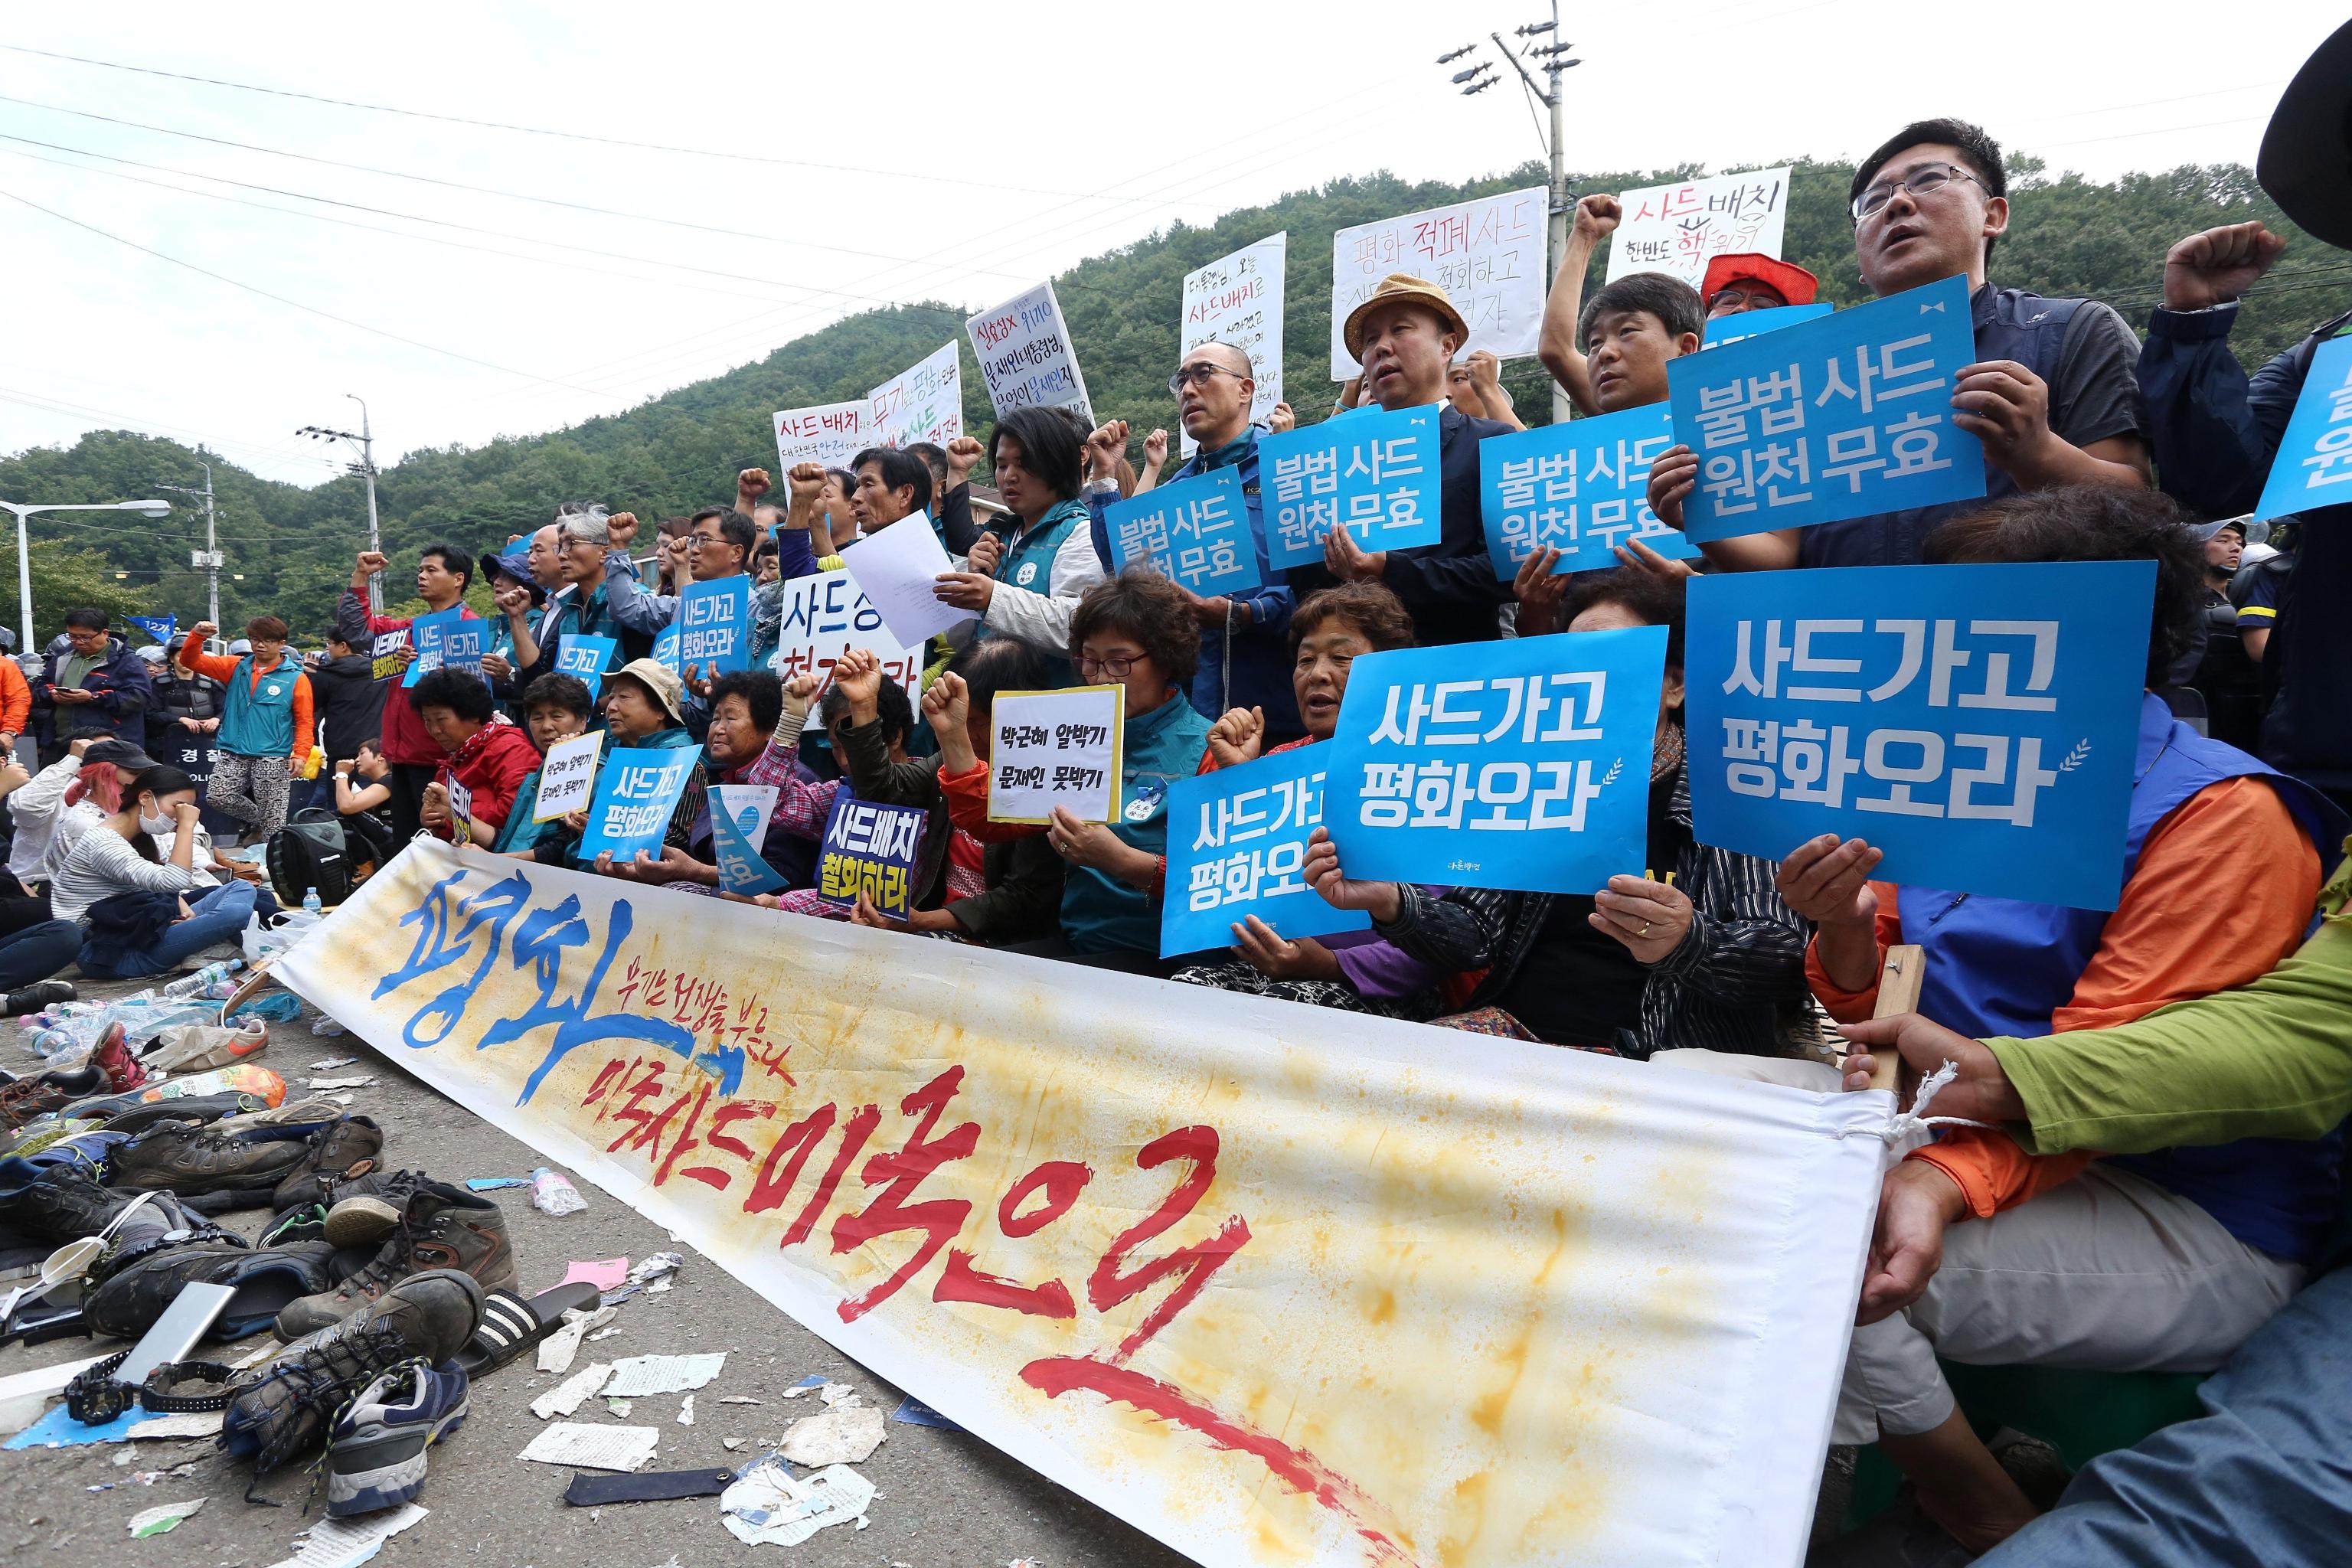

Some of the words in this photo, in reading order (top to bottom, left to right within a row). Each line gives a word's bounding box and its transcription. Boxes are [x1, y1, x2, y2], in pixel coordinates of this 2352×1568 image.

[1634, 188, 1704, 222] 사드
[1709, 181, 1779, 218] 배치
[1354, 229, 1405, 274] 평화
[1413, 213, 1469, 261] 적폐
[1475, 201, 1530, 245] 사드
[1625, 239, 1671, 263] 한반도
[1189, 266, 1232, 294] 대통령님,
[1237, 254, 1257, 279] 오늘
[1436, 250, 1521, 295] 철회하고
[1227, 311, 1264, 335] 사라졌고
[913, 365, 941, 402] 평화
[1694, 363, 1805, 449] 불법
[1815, 333, 1945, 414] 사드
[780, 415, 819, 437] 사드
[782, 443, 819, 457] 대한민국
[1272, 446, 1338, 503] 불법
[1344, 436, 1423, 485] 사드
[1703, 437, 1813, 518] 원천
[1821, 412, 1952, 494] 무효
[1497, 449, 1577, 509] 불법
[1585, 434, 1670, 490] 사드
[1119, 510, 1169, 562] 불법
[1171, 495, 1235, 540] 사드
[1277, 497, 1338, 552] 원천
[1346, 486, 1423, 537] 무효
[1501, 504, 1579, 563] 원천
[1179, 538, 1243, 586] 무효
[684, 593, 734, 627] 사드가고
[371, 629, 409, 657] 사드배치
[420, 624, 442, 648] 사드
[444, 632, 480, 657] 사드가고
[683, 628, 735, 660] 평화오라
[418, 650, 443, 673] 평화
[556, 647, 599, 673] 사드가고
[1722, 619, 2060, 712] 사드가고
[1367, 671, 1607, 746] 사드가고
[1001, 726, 1049, 749] 박근혜
[1055, 724, 1106, 750] 알박기
[547, 760, 567, 776] 박근혜
[569, 753, 592, 772] 알박기
[612, 764, 684, 799] 사드가고
[999, 766, 1045, 789] 문재인
[1052, 766, 1103, 791] 못박기
[1722, 717, 2058, 828] 평화오라
[541, 784, 562, 802] 문재인
[564, 779, 586, 796] 못박기
[1358, 759, 1602, 832] 평화오라
[603, 804, 665, 838] 평화오라
[828, 804, 920, 863] 사드배치
[821, 852, 907, 913] 철회하라
[1188, 841, 1315, 912] 평화오
[371, 868, 744, 1108] 평화
